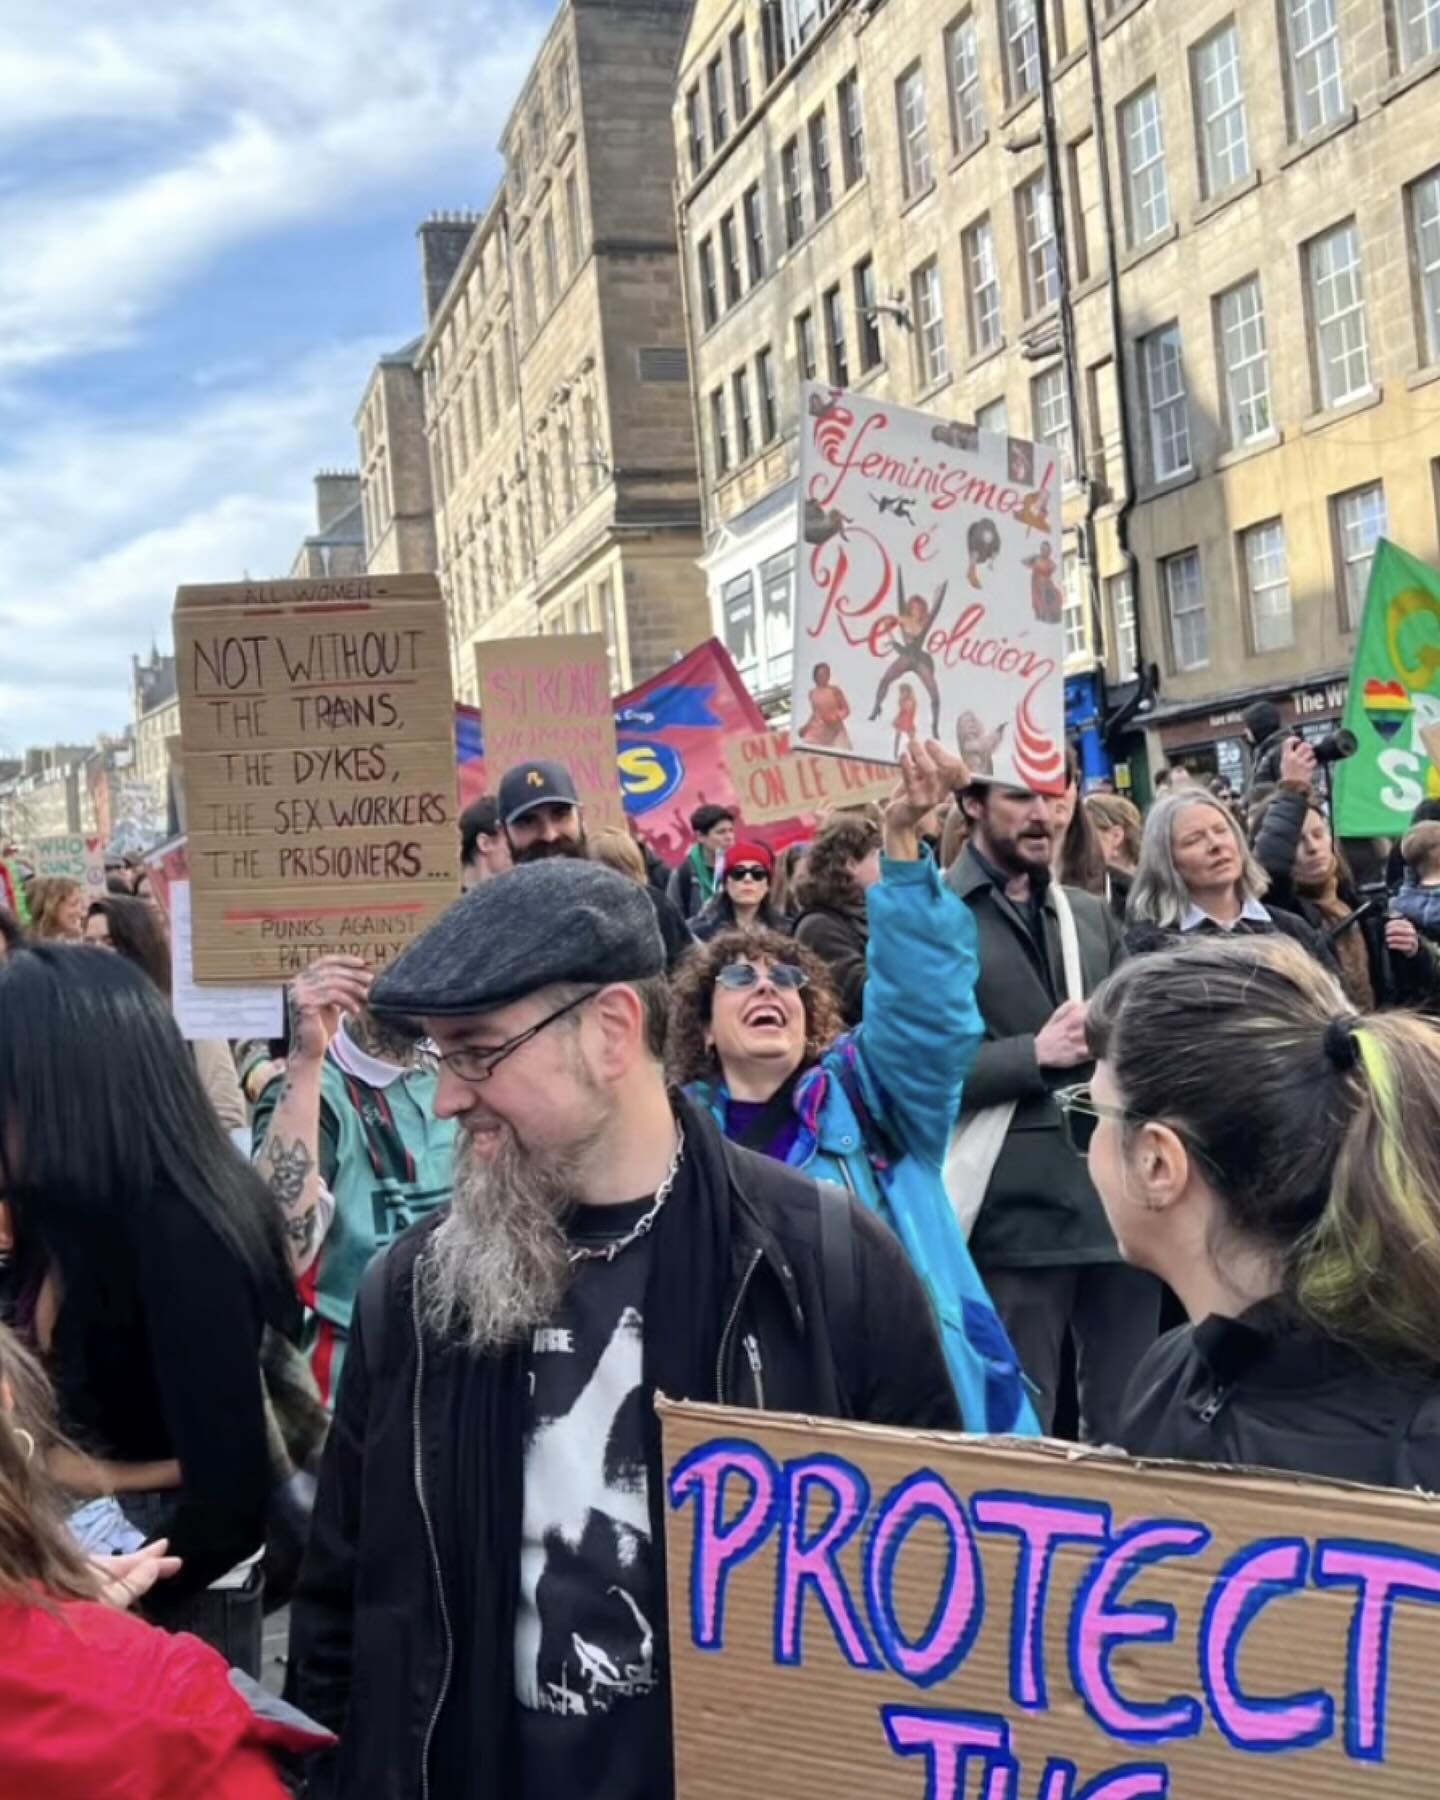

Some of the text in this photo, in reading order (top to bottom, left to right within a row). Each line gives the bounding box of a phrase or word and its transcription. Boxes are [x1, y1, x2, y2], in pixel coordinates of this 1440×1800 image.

[246, 580, 372, 603] ALL WOMEN
[194, 629, 425, 692] NOT WITHOUT
[207, 692, 405, 738] THE TRANS,
[1292, 689, 1325, 714] The
[218, 743, 400, 788] THE DYKES,
[748, 764, 789, 808] ON
[796, 756, 829, 799] LE
[206, 792, 447, 836] THE SEX WORKERS
[202, 851, 264, 879] THE
[260, 913, 416, 939] PUNKS AGAINST
[668, 1436, 1440, 1763] PROTECT
